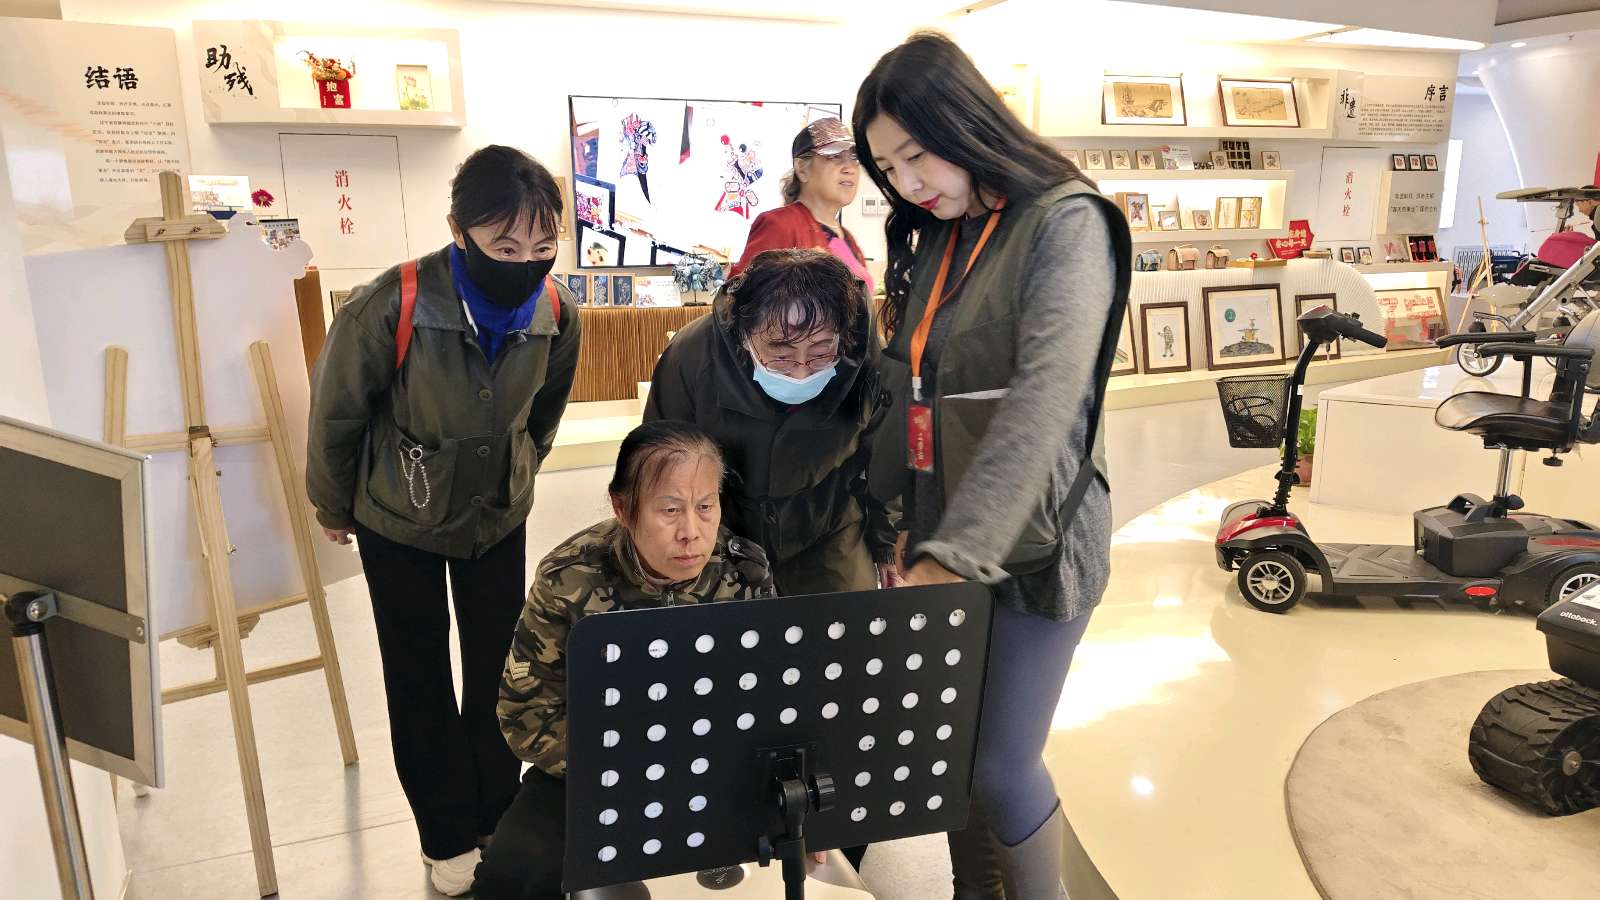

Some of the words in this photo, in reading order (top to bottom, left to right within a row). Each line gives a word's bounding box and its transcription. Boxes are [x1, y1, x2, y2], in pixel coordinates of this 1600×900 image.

[84, 65, 139, 90] 结语
[205, 45, 254, 96] 助残
[1424, 84, 1449, 102] 序言
[334, 168, 355, 236] 消火栓
